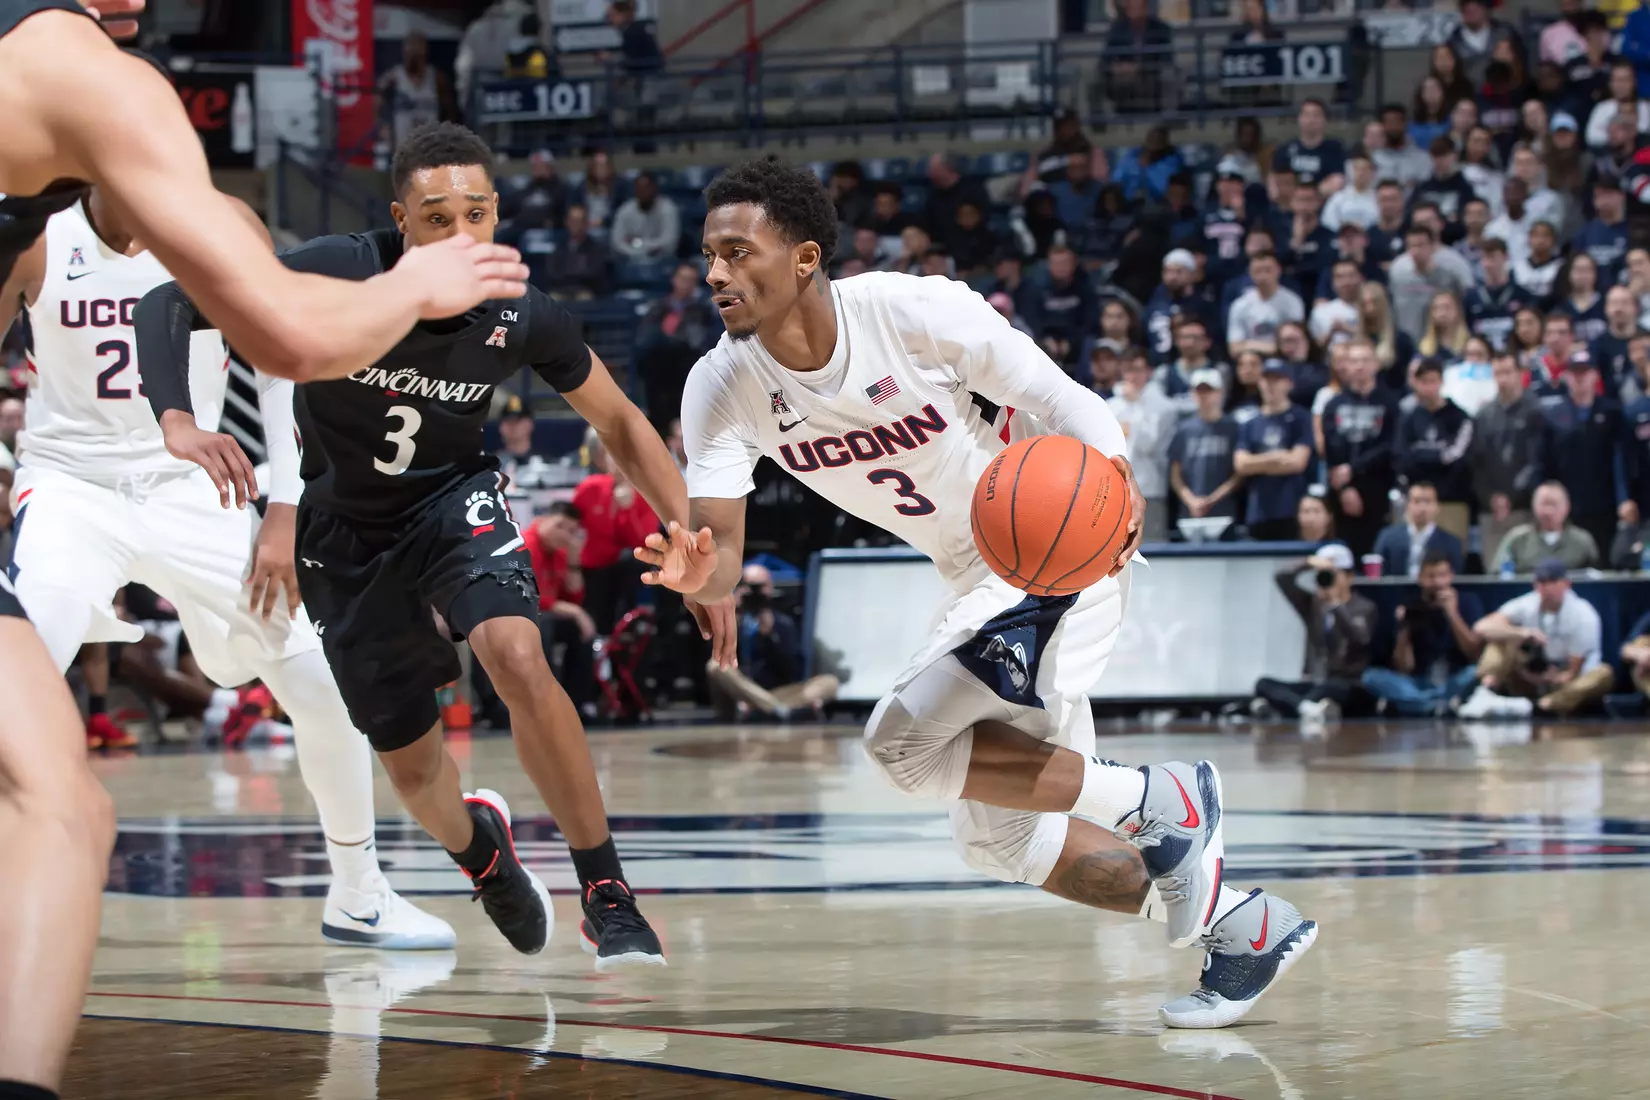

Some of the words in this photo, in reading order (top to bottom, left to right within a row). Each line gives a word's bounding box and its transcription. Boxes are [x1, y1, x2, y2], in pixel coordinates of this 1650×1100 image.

[1279, 46, 1342, 80] 101
[534, 82, 591, 116] 101
[501, 310, 519, 322] CM
[96, 340, 148, 399] 2
[348, 366, 491, 402] CINCINNATI
[374, 405, 422, 476] 3
[778, 403, 949, 472] UCONN
[866, 468, 937, 516] 3
